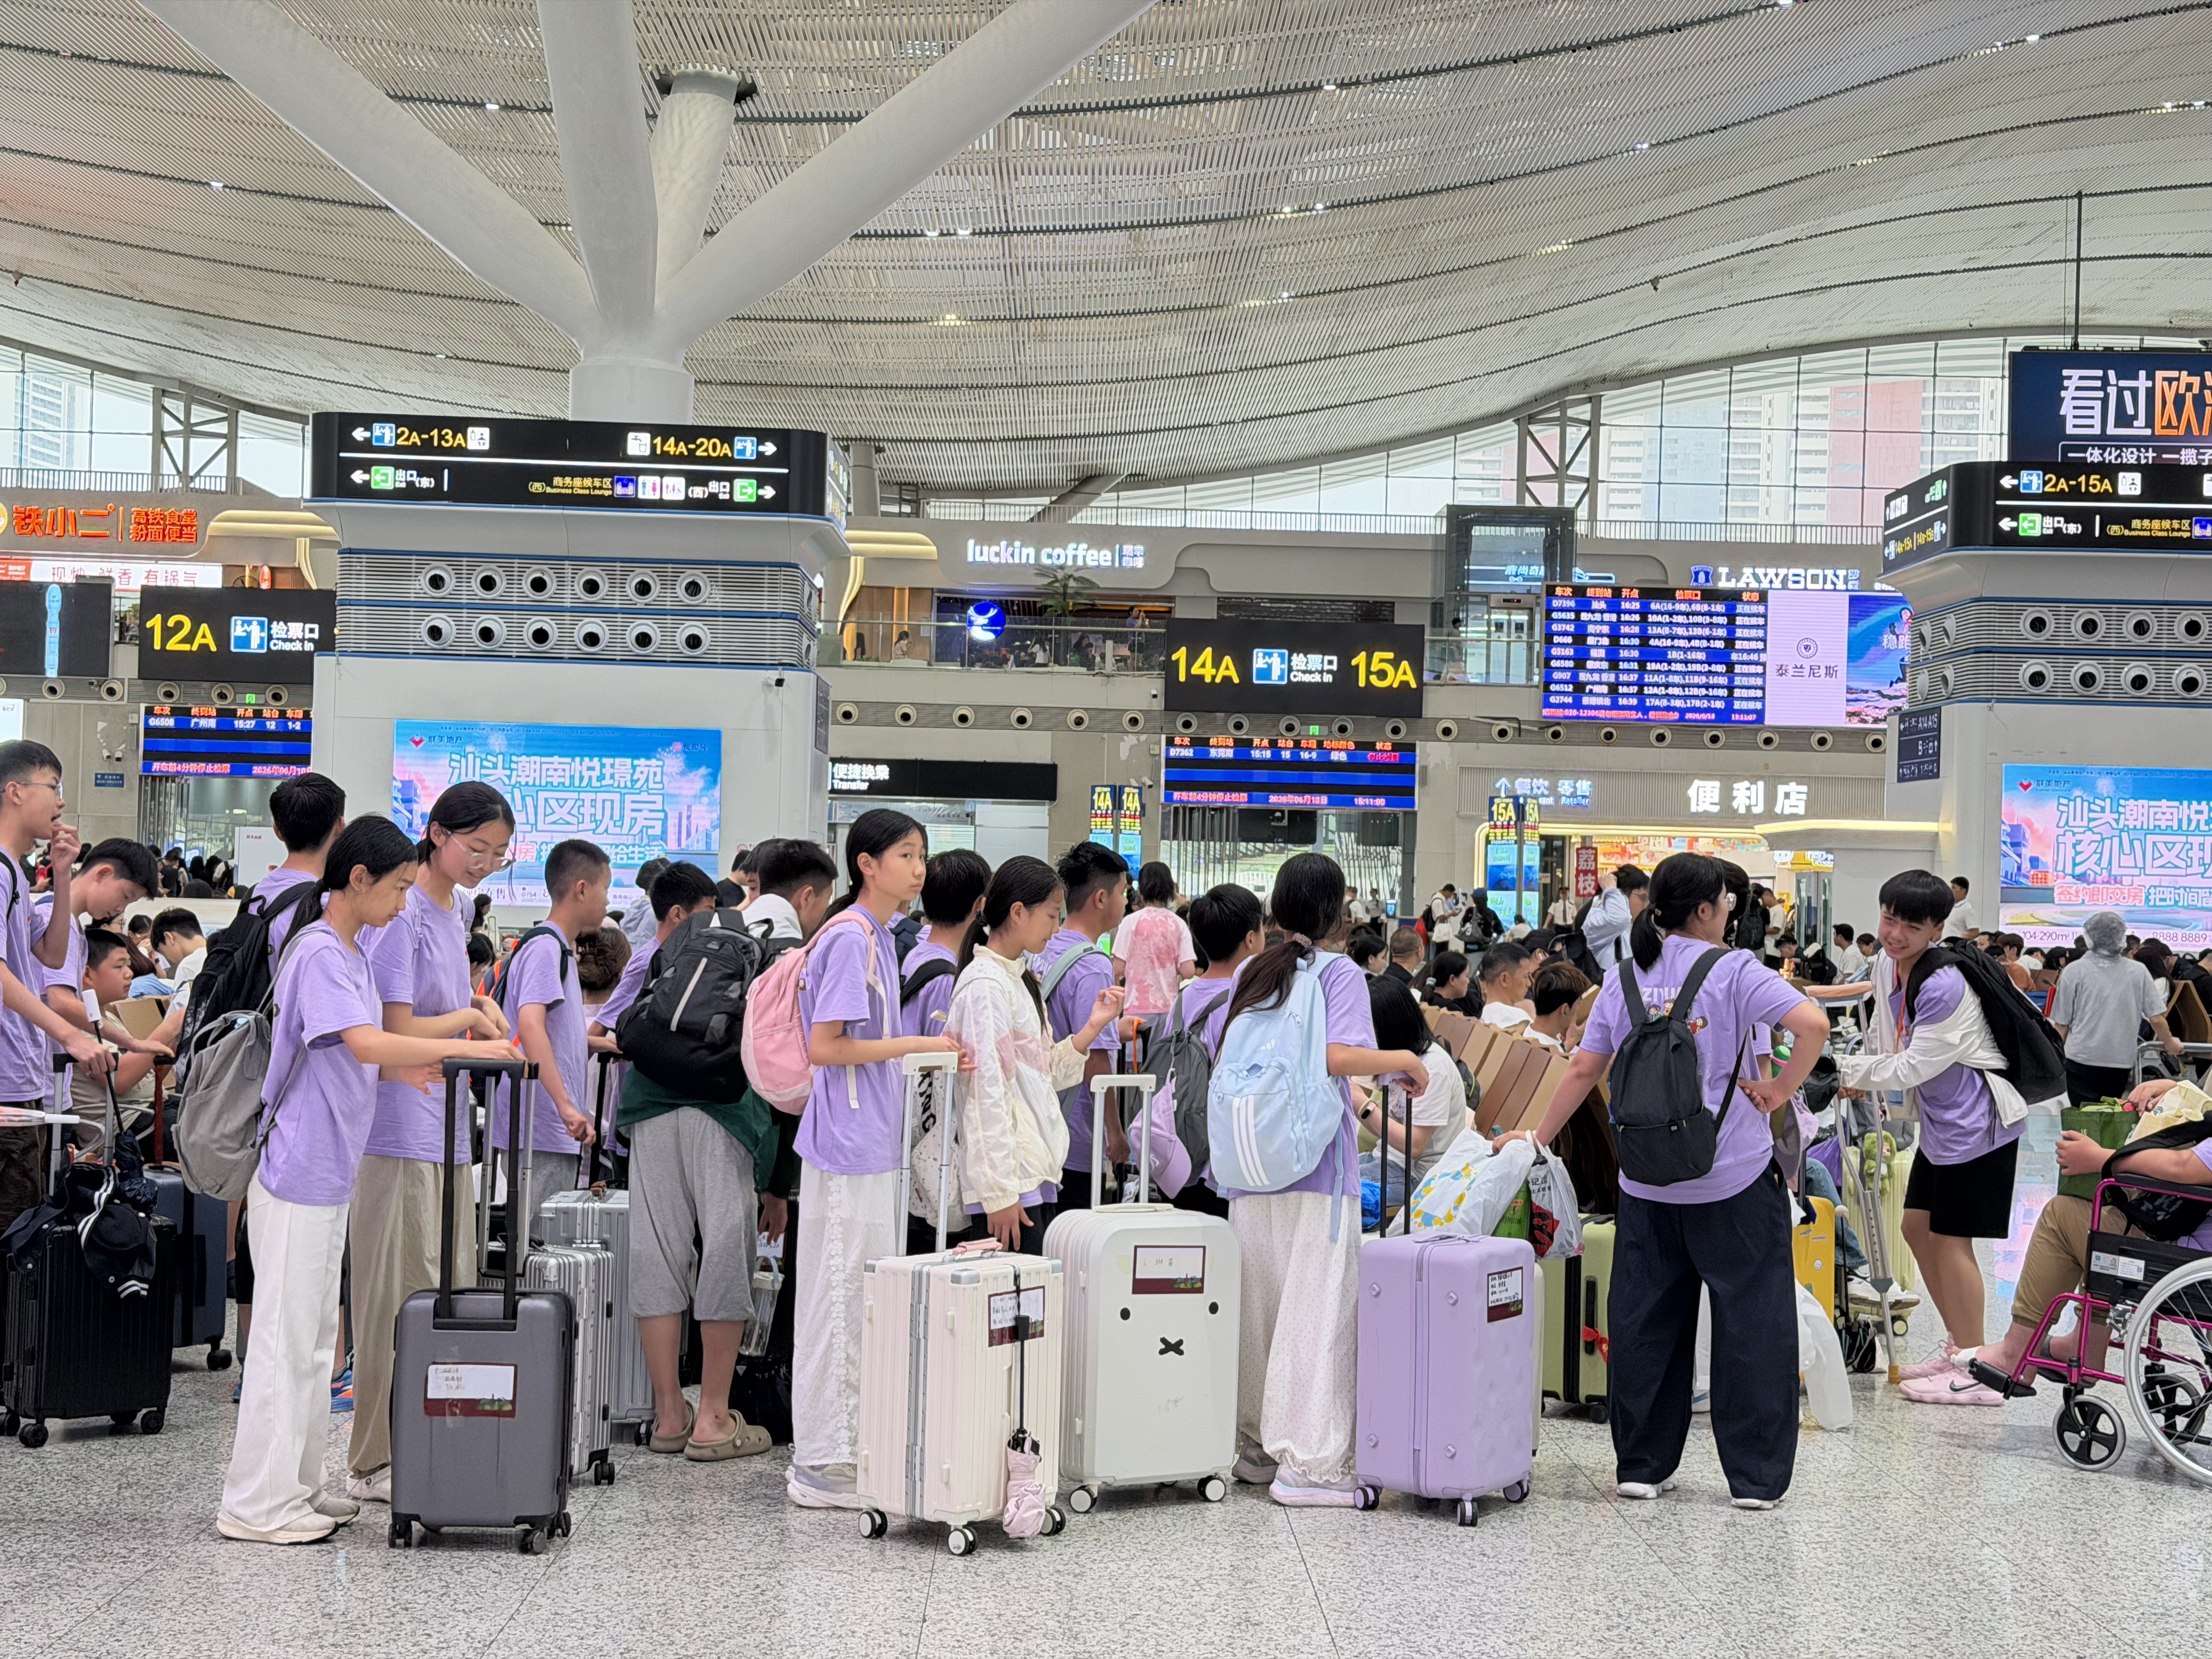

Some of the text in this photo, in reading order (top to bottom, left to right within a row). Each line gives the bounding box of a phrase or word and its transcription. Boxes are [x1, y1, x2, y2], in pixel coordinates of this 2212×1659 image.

[2060, 369, 2212, 436] 看过欧
[396, 427, 466, 447] 2A-13A
[653, 436, 732, 457] 14A-20A
[2067, 448, 2157, 465] 一体化设计
[396, 470, 417, 481] 出口
[553, 477, 612, 489] 商务座候车区
[2044, 474, 2112, 493] 2A-15A
[709, 481, 730, 493] 出口
[13, 504, 110, 537] 铁小二
[131, 507, 198, 525] 高铁食堂
[2043, 516, 2064, 528] 出口
[2132, 519, 2191, 530] 商务座候车区
[129, 525, 198, 543] 粉面便当
[968, 539, 1112, 566] luckin coffee
[1718, 567, 1847, 590] LAWSON
[146, 614, 217, 652] 12A
[270, 620, 319, 640] 检票口
[270, 640, 314, 651] Check in
[1171, 646, 1239, 684] 14A
[1291, 653, 1338, 672] 检票口
[1351, 651, 1417, 689] 15A
[1775, 664, 1838, 679] 泰兰尼斯
[1290, 671, 1332, 682] Check in
[233, 720, 256, 729] 15:27
[266, 721, 276, 729] 12
[1170, 748, 1193, 757] D7362
[1250, 750, 1271, 758] 15:15
[448, 753, 665, 789] 汕头潮南悦璟苑
[833, 763, 890, 780] 便捷换乘
[832, 779, 870, 790] Transfer
[1558, 779, 1592, 795] 零售
[1093, 792, 1113, 810] 14A
[1122, 792, 1141, 811] 14A
[1687, 779, 1808, 815] 便利店
[512, 788, 665, 836] 心区现房
[1492, 803, 1516, 821] 15A
[1525, 803, 1539, 822] 15A
[2057, 796, 2212, 831] 汕头潮南悦
[1578, 849, 1596, 895] 荔枝
[2055, 884, 2145, 905] 签约即交房
[2181, 932, 2208, 943] 8889
